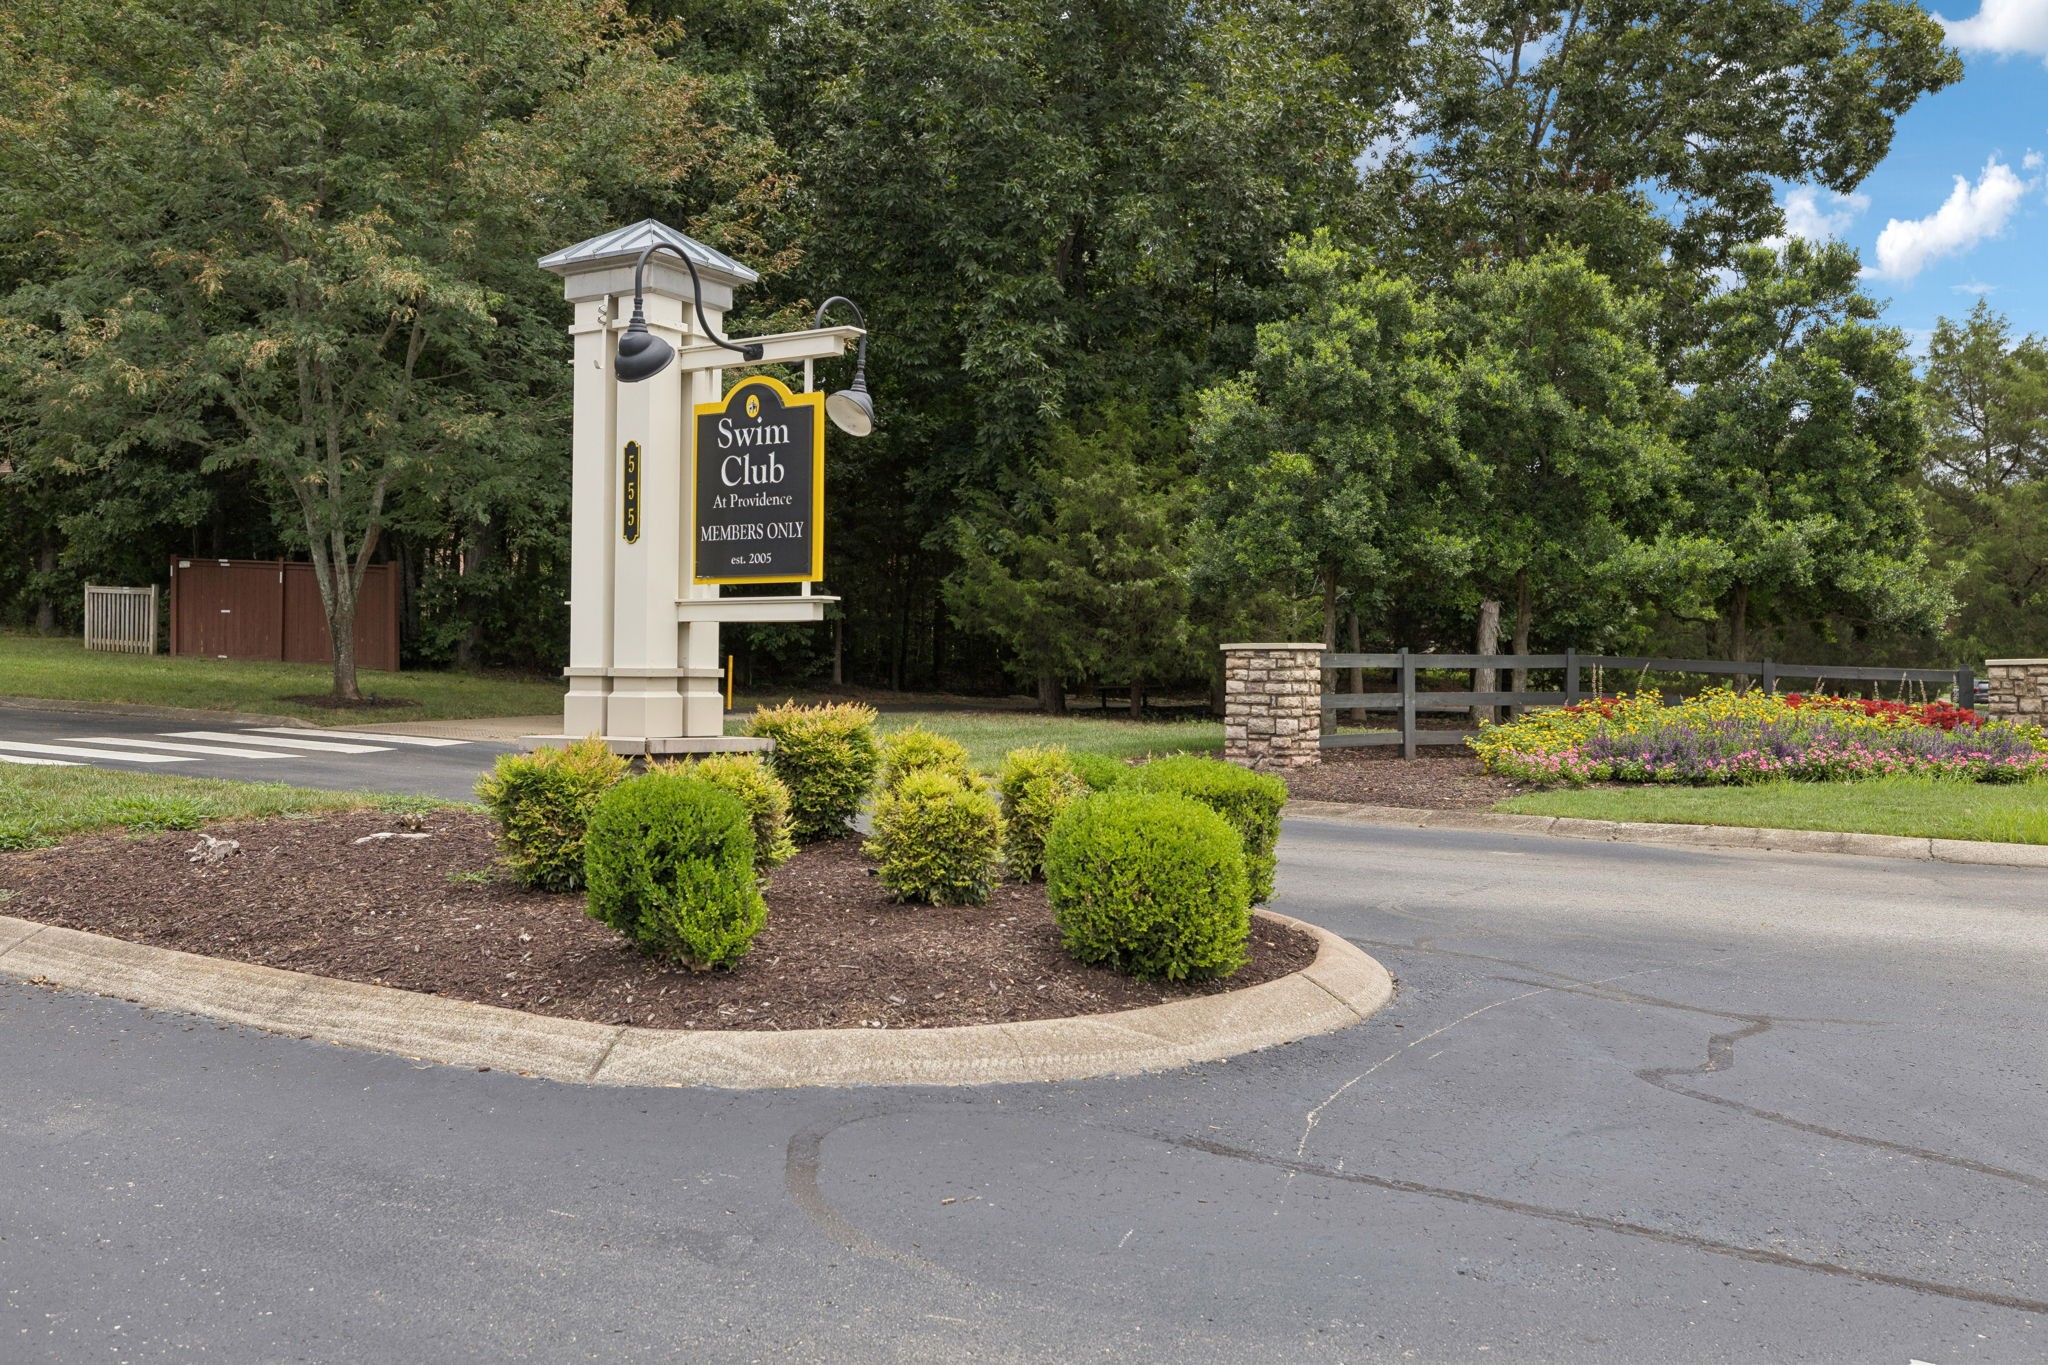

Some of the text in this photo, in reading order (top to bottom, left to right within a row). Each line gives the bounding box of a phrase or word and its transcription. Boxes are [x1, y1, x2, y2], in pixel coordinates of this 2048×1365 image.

[717, 416, 790, 449] Swim
[720, 451, 785, 487] Club
[627, 455, 635, 526] 555
[713, 492, 793, 509] At Providence
[701, 521, 804, 542] MEMBERS ONLY
[731, 552, 772, 565] est. 2005
